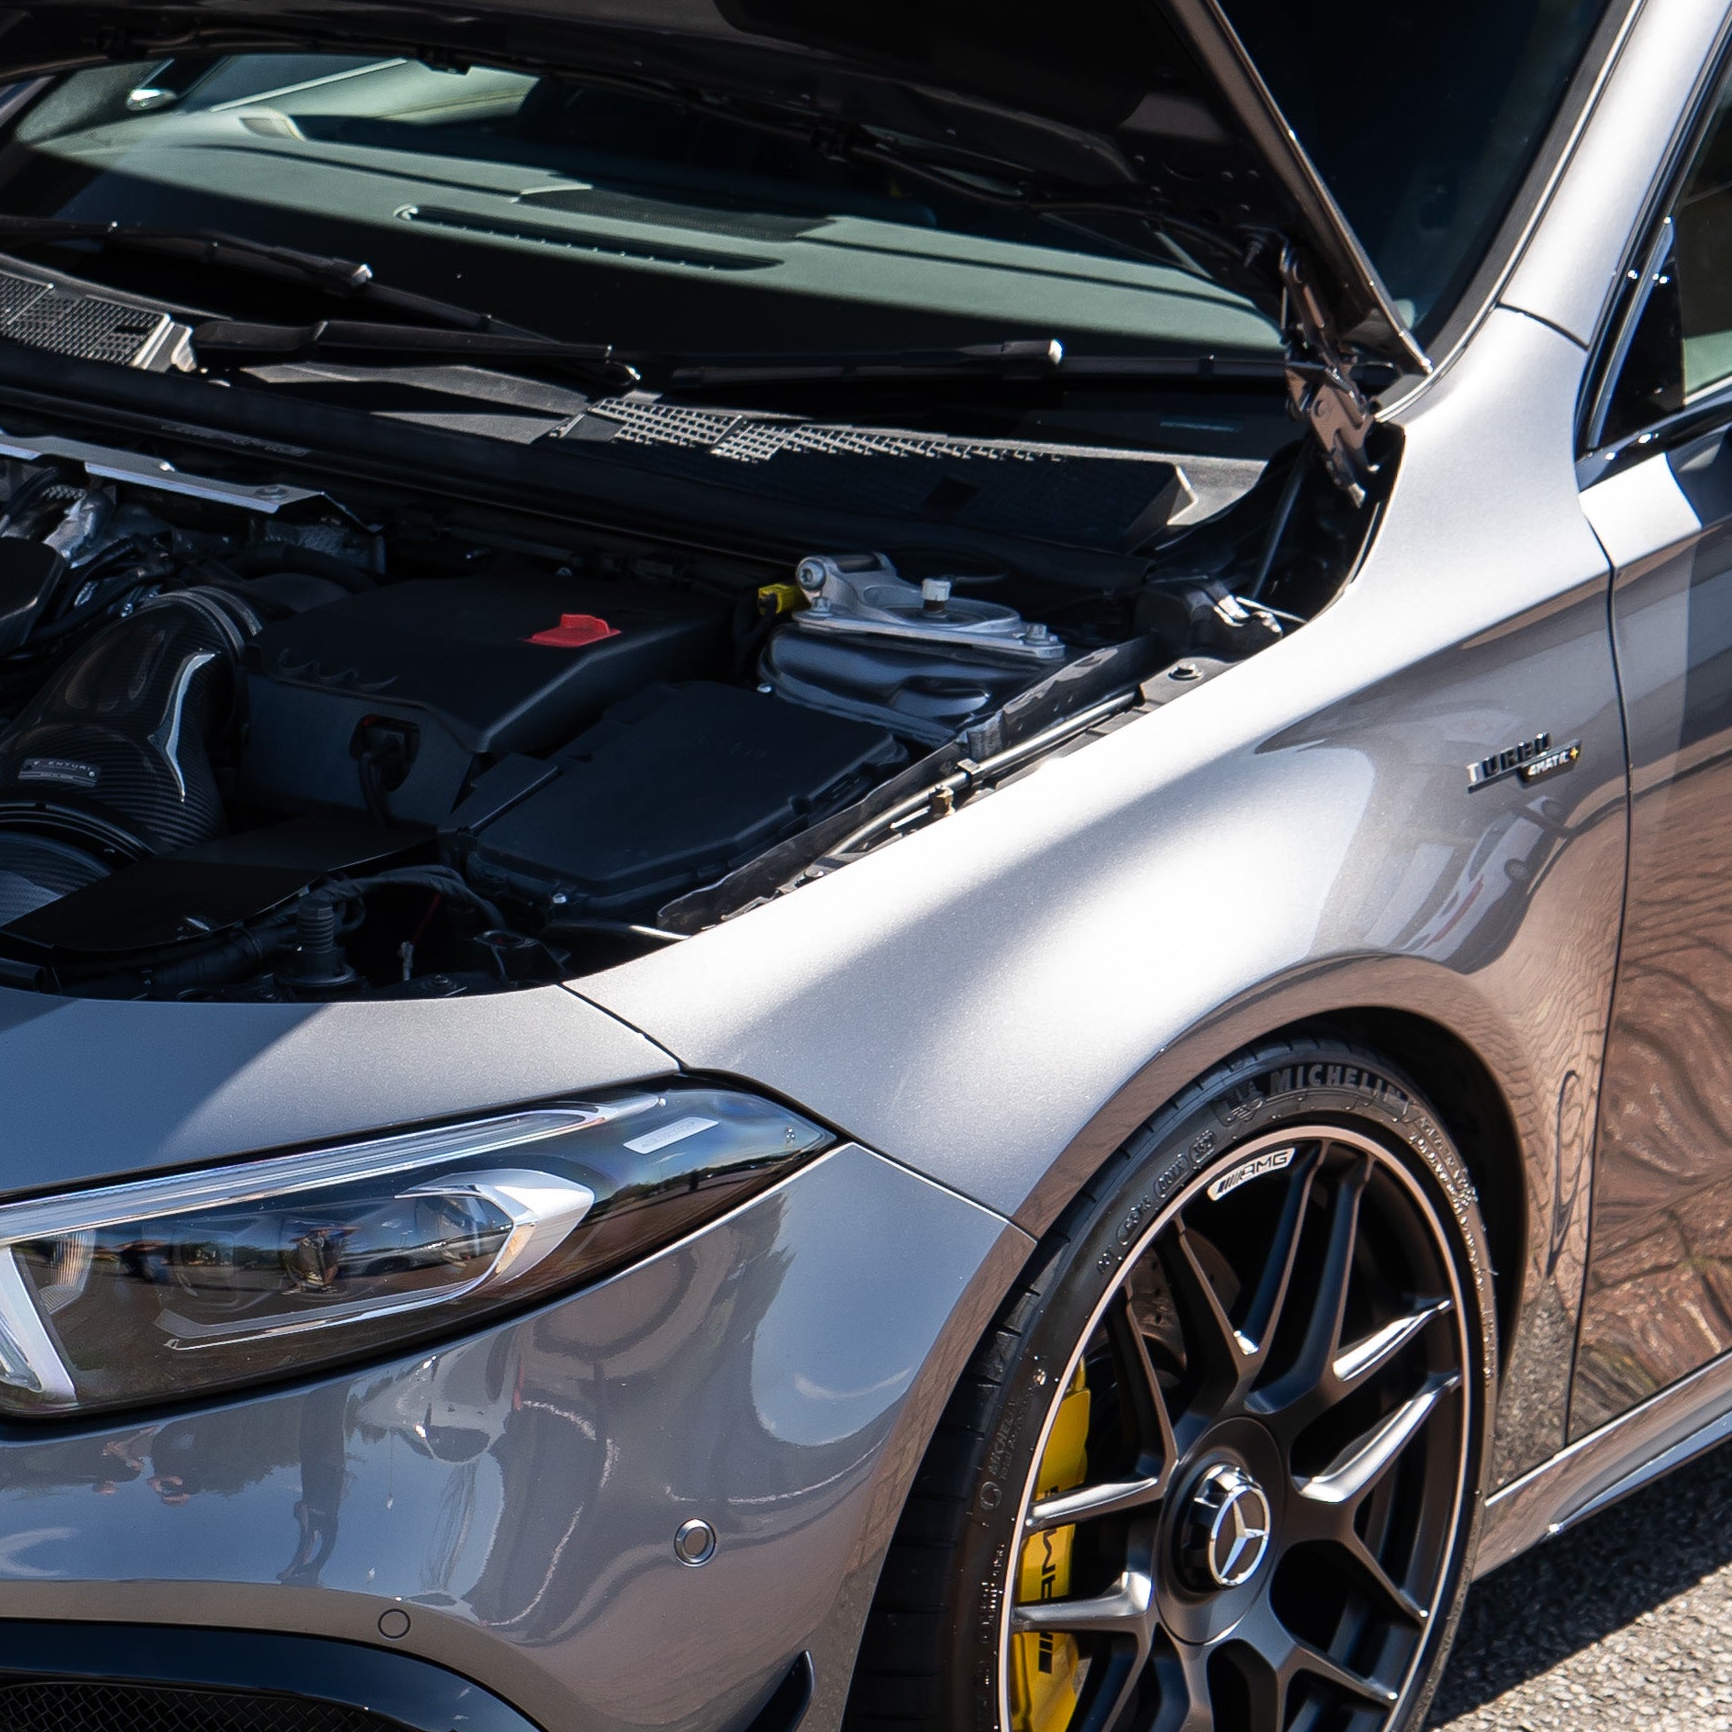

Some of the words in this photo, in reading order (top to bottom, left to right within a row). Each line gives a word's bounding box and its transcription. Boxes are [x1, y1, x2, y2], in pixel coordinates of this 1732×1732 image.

[1466, 732, 1553, 784] TURBO
[1269, 1063, 1410, 1103] MICHELIN
[1241, 1150, 1289, 1177] AMG
